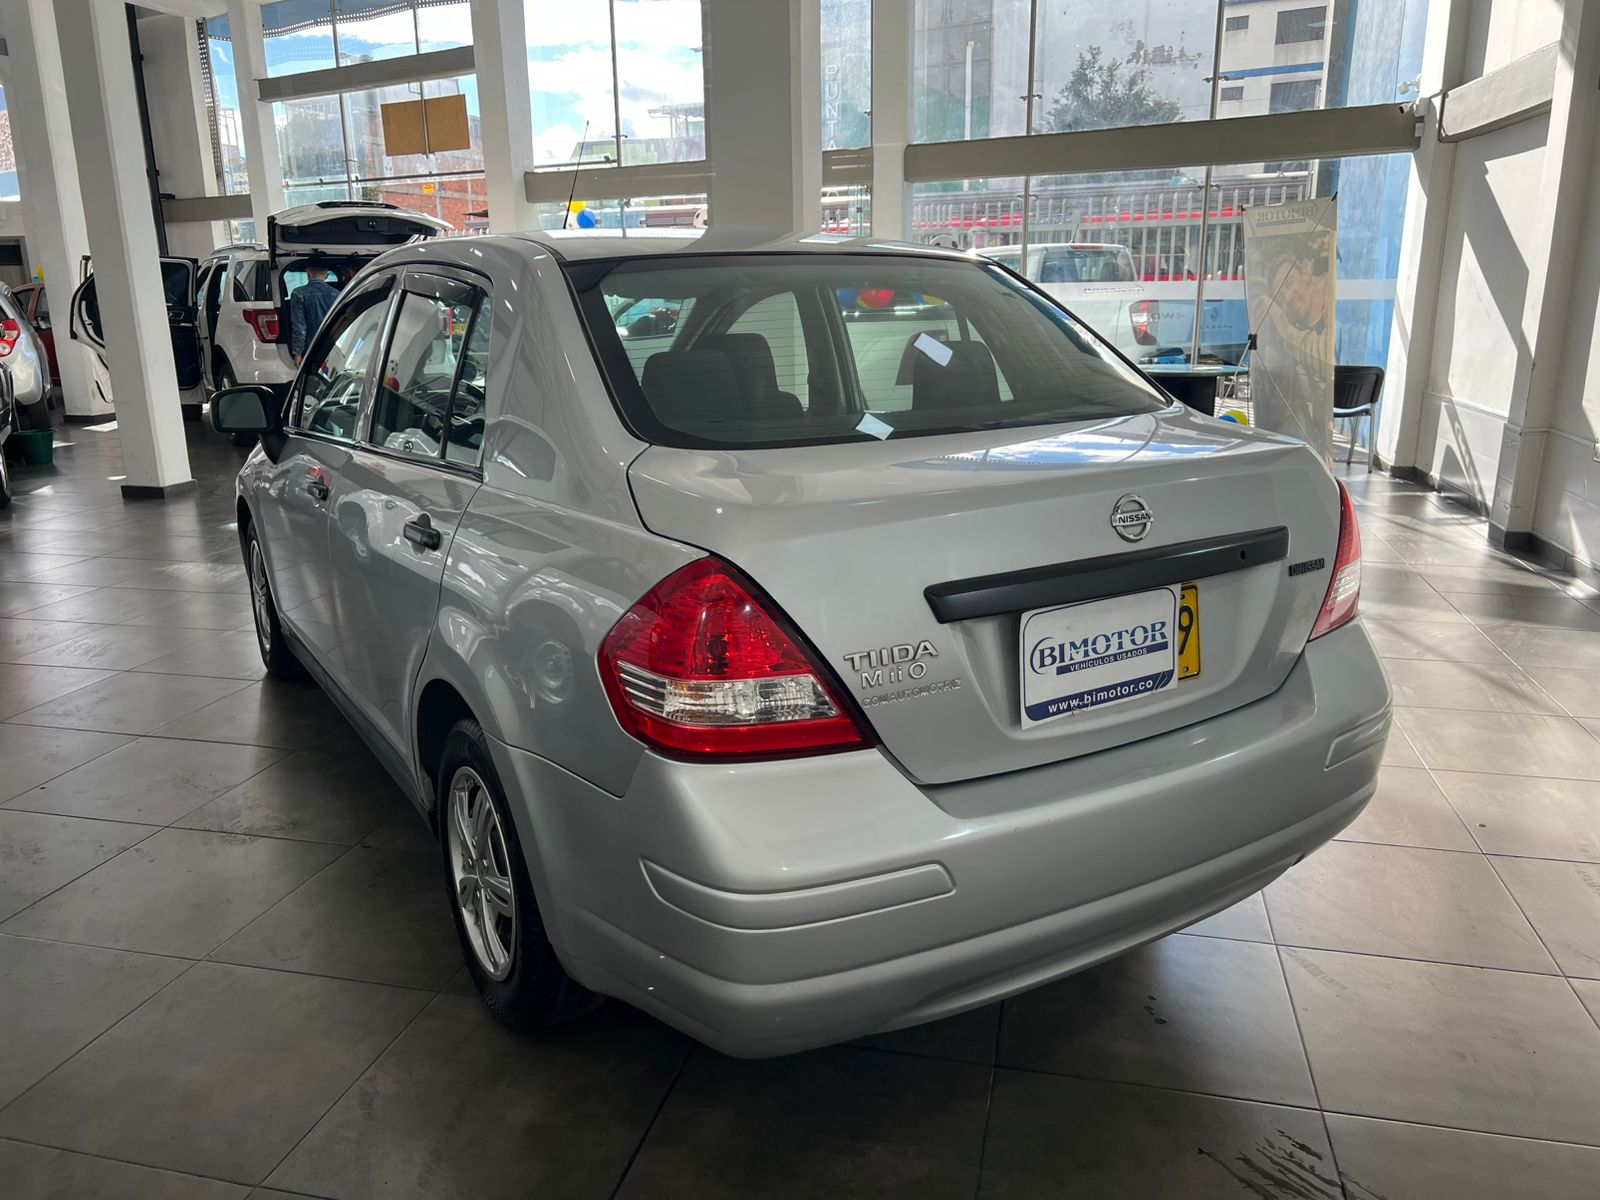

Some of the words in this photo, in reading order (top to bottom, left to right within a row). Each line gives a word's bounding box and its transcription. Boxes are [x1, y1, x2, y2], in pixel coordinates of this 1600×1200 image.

[1118, 512, 1151, 524] NISSAN
[843, 639, 938, 672] TIIDA
[1038, 621, 1168, 670] BIMOTOR
[1069, 655, 1115, 672] VEHÍCULOS
[1116, 647, 1148, 662] USADOS
[1047, 679, 1154, 714] www.bimotor.co
